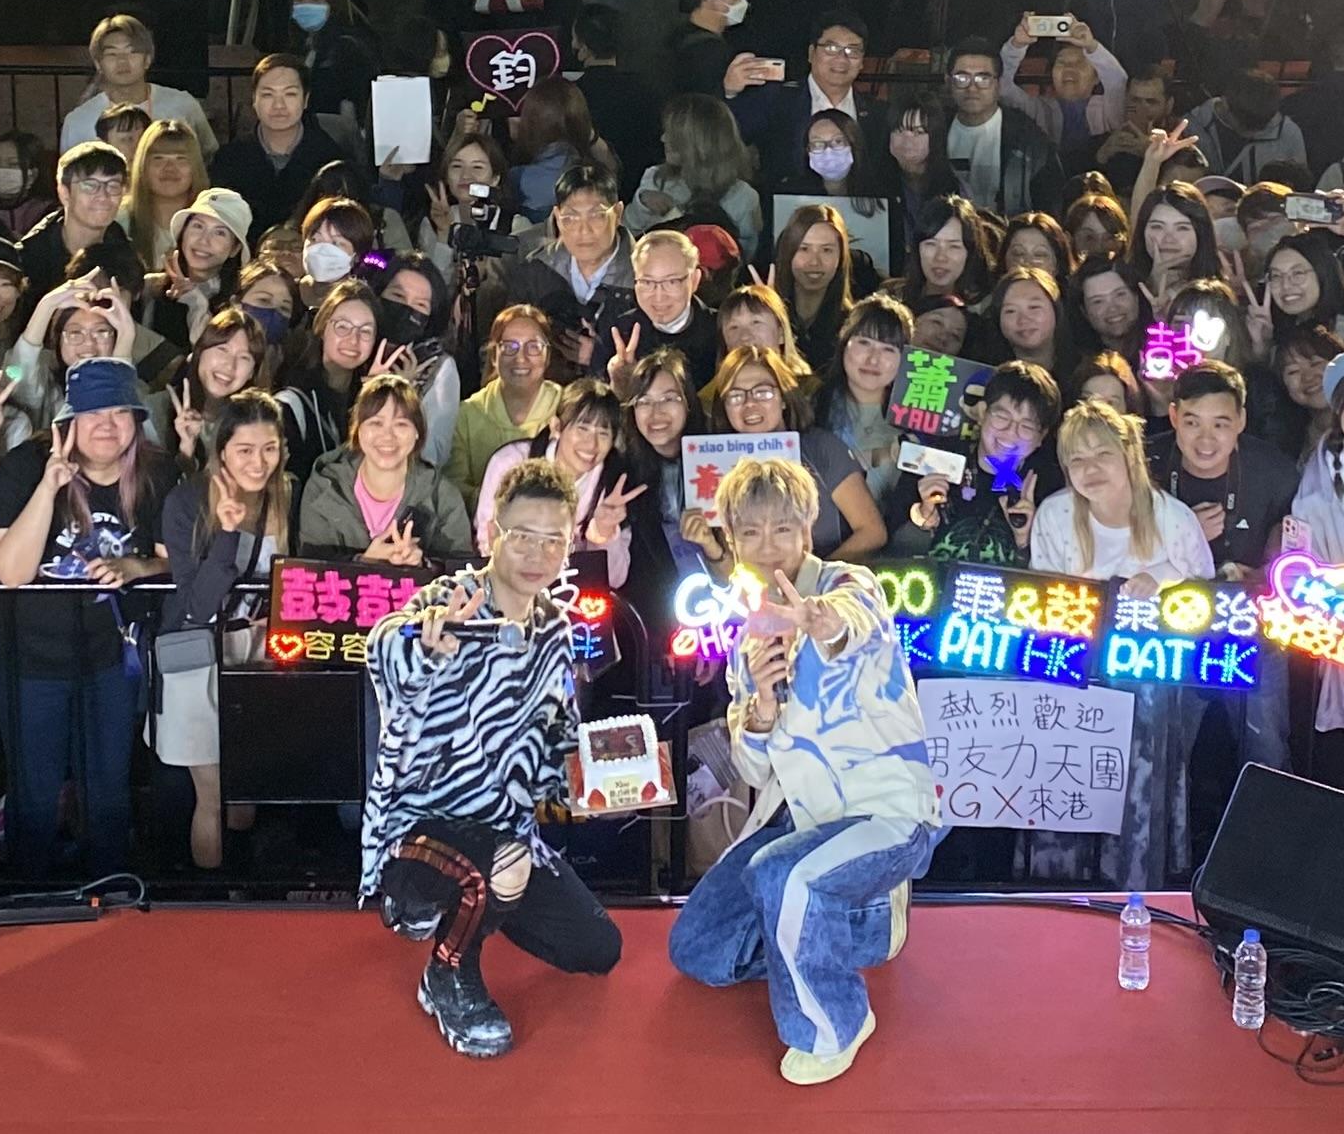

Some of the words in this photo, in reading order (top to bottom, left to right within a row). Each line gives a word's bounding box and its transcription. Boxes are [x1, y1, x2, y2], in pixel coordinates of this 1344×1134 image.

[1145, 321, 1203, 379] 鼓
[699, 441, 725, 454] xiao
[727, 439, 755, 454] bing
[757, 438, 783, 451] chih
[938, 613, 1023, 671] PAT
[1022, 633, 1087, 681] HK
[1107, 633, 1197, 682] PAT
[1199, 641, 1258, 684] HK
[939, 689, 1115, 733] 熱烈歡迎
[926, 734, 1124, 792] 男友力天團
